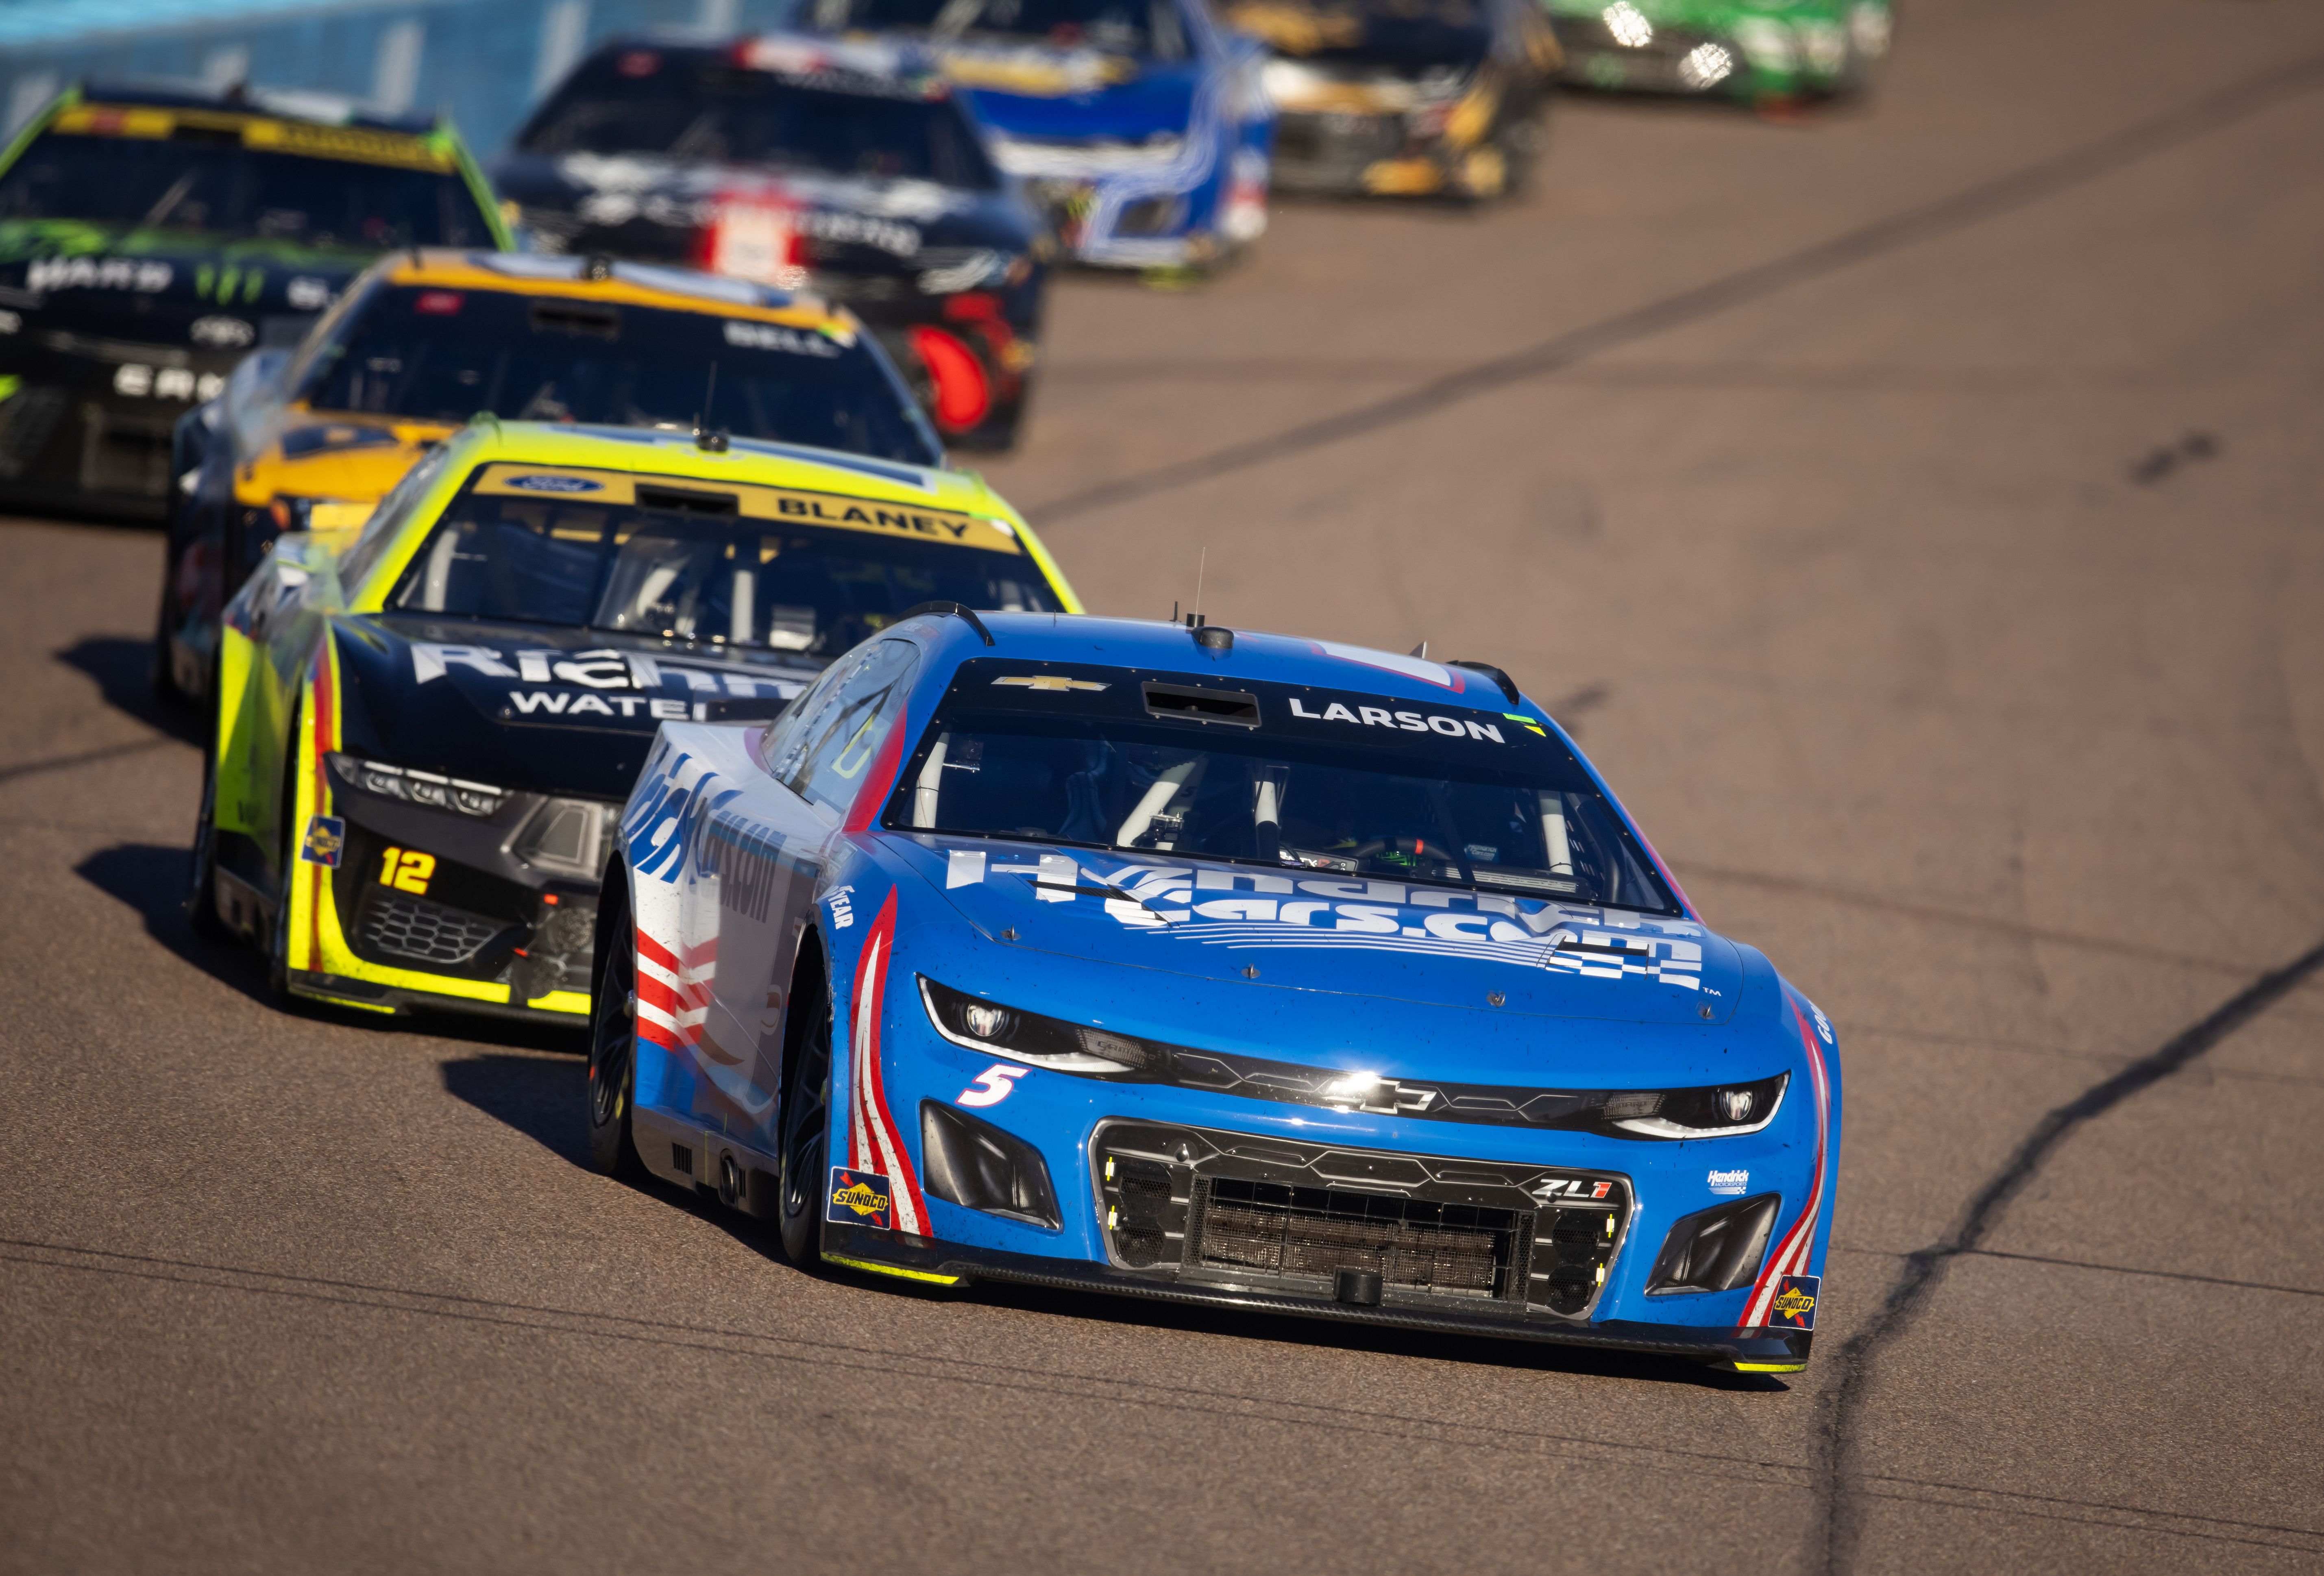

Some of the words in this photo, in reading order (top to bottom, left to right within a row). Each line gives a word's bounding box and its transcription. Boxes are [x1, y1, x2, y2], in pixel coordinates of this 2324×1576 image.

[778, 498, 968, 538] BLANEY
[1289, 698, 1505, 743] LARSON
[379, 846, 436, 895] 12
[1702, 987, 1722, 997] TM
[956, 1064, 1032, 1108] 5
[1708, 1170, 1749, 1186] Hendrick
[1531, 1179, 1612, 1198] ZL1
[835, 1190, 886, 1210] SUNOCO
[1775, 1296, 1812, 1310] SUNOCO
